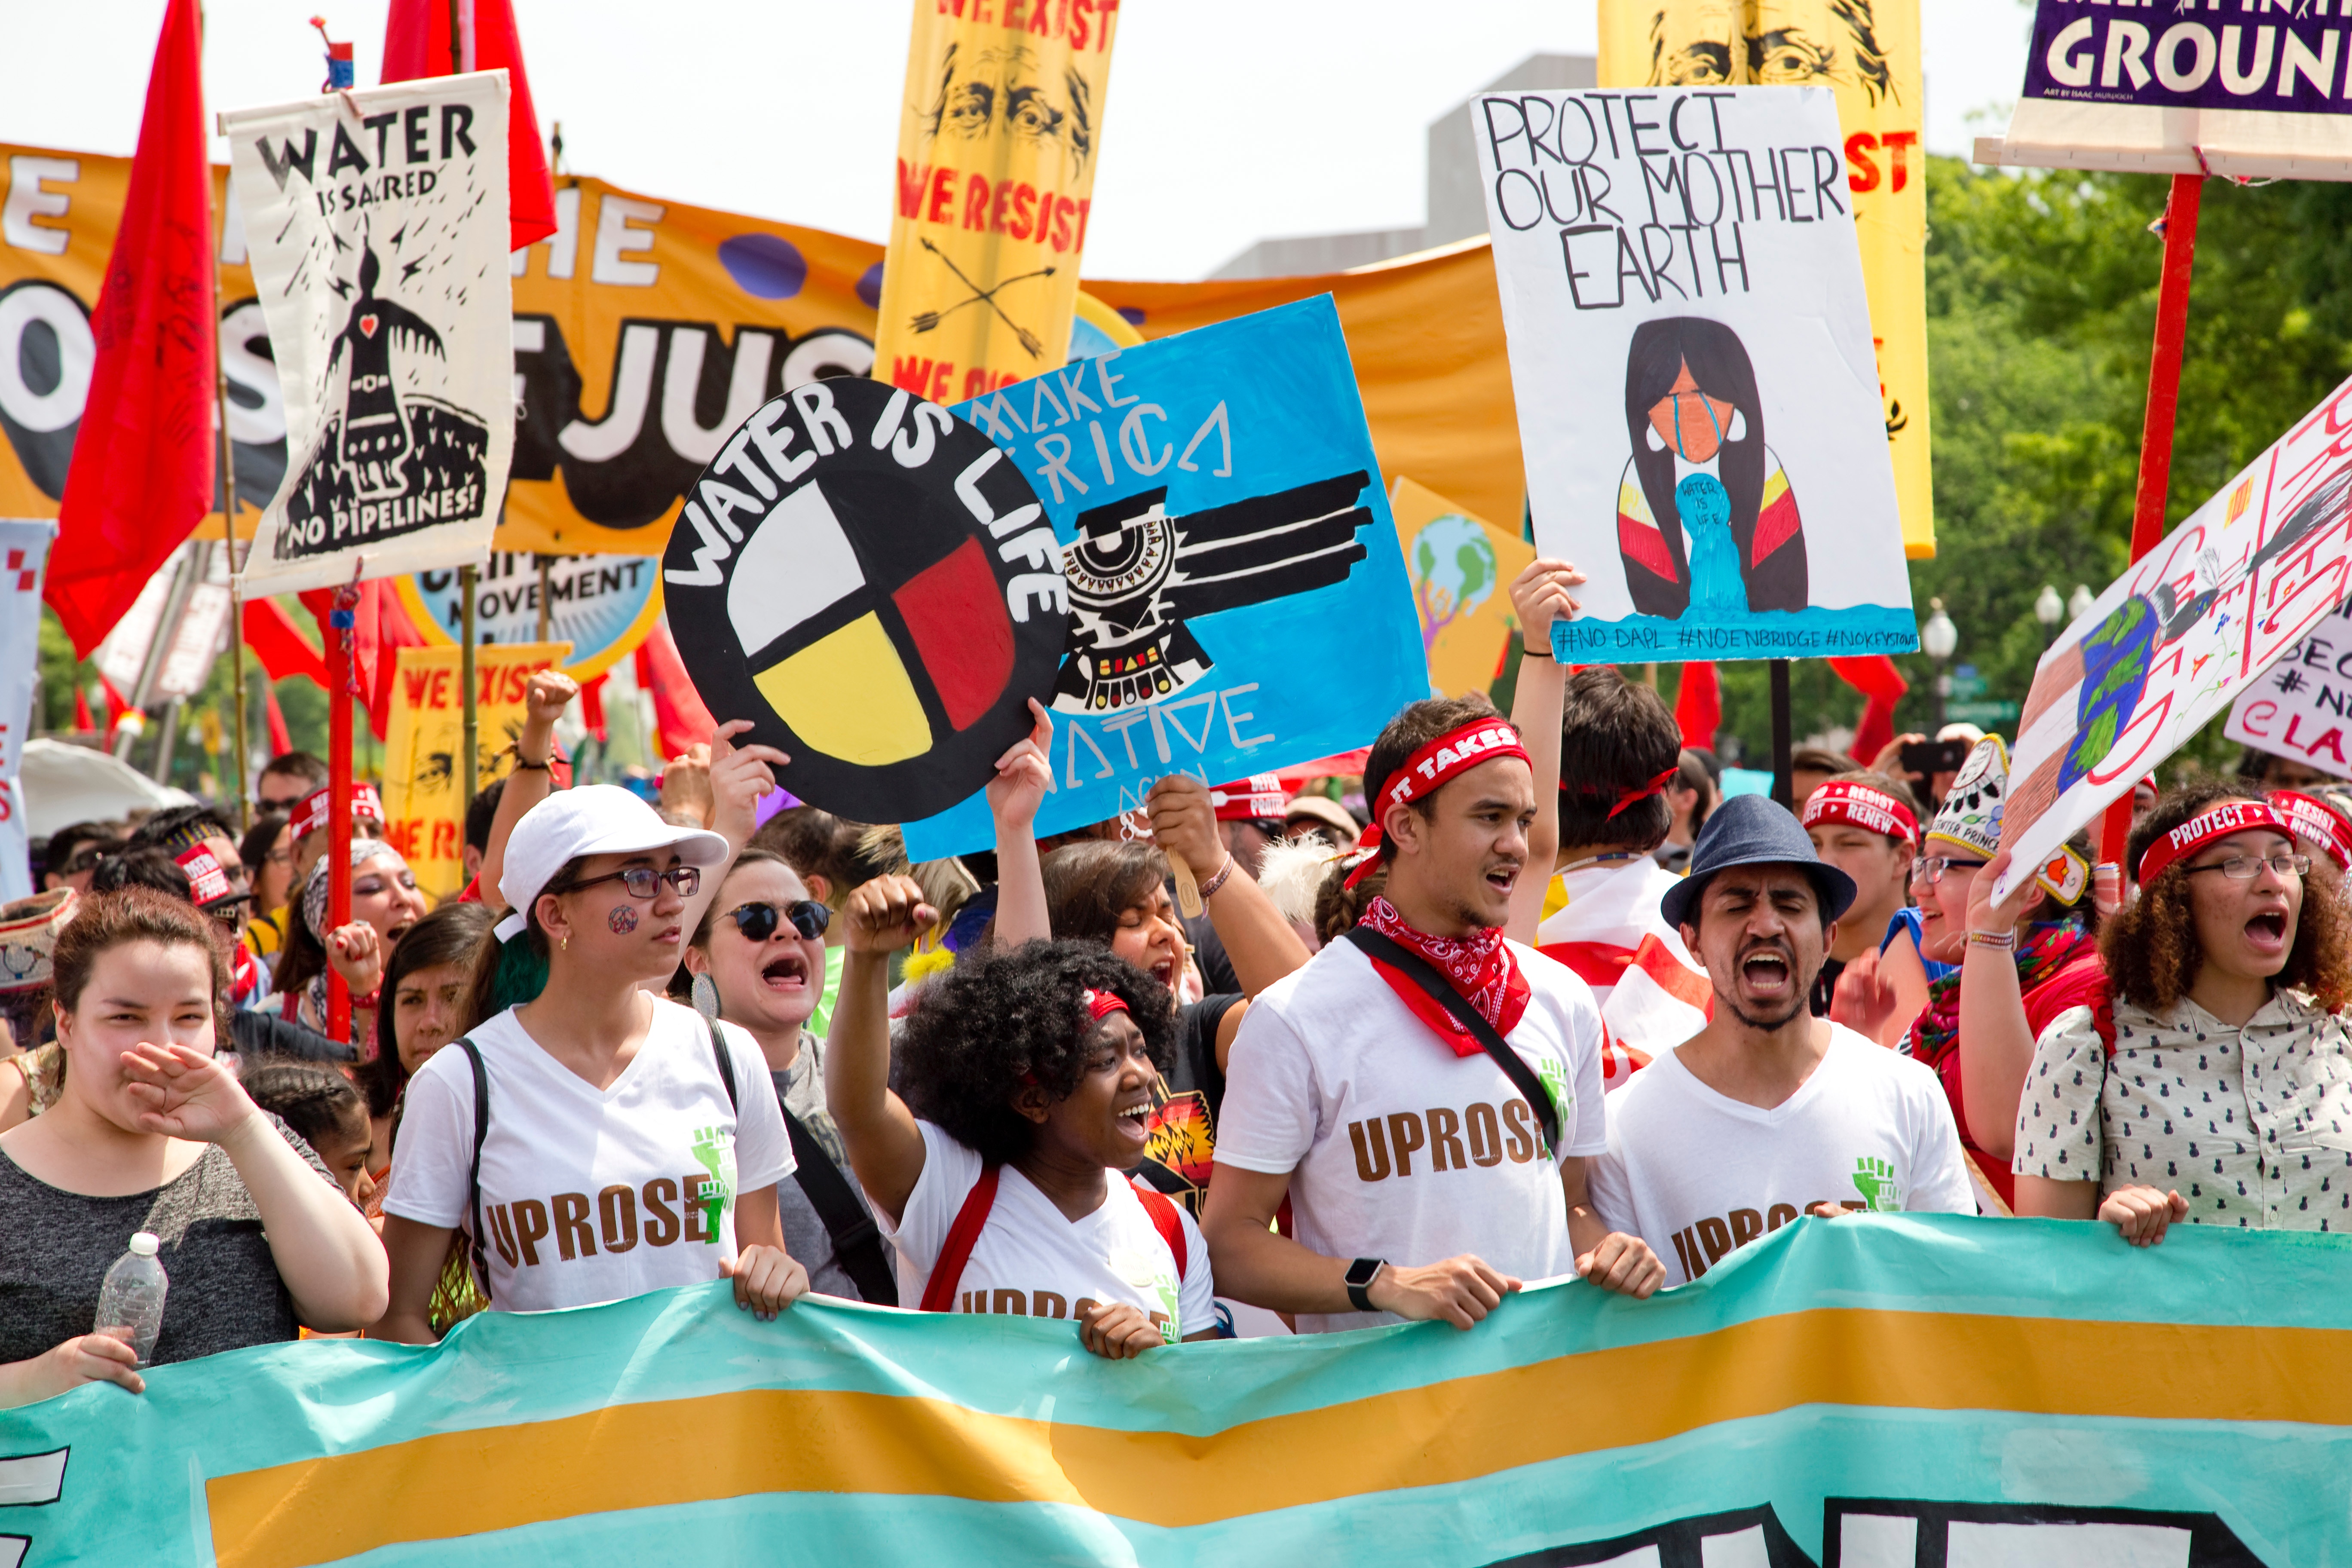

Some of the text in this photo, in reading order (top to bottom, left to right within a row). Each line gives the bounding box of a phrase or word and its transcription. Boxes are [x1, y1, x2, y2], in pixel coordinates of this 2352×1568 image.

[2047, 16, 2352, 99] GROUN
[256, 105, 477, 193] WATER
[1482, 92, 1735, 172] PROTECT
[317, 170, 437, 216] IS SACRED
[897, 157, 1091, 254] WE RESIST
[1497, 147, 1845, 230] OUR MOTHER
[1560, 221, 1749, 309] EARTH
[969, 351, 1139, 440] MAKE
[286, 484, 477, 548] NO PIPELINES!
[664, 383, 1069, 622] WATER IS LIFE
[1681, 482, 1718, 496] WATER
[1696, 497, 1708, 509] IS
[1696, 513, 1720, 525] LIFE
[1558, 628, 1606, 652] #NO
[1615, 627, 1666, 650] DAPL
[1678, 626, 1820, 649] #NOENBRIDGE
[403, 667, 451, 710] WE
[1390, 727, 1517, 803] IT TAKES
[1847, 803, 1894, 834] RENEW
[1848, 785, 1895, 812] RESIST
[2293, 799, 2337, 832] RESIST
[2169, 805, 2245, 850] PROTECT
[2290, 817, 2332, 851] RENEW
[486, 1174, 712, 1268] UPROSE
